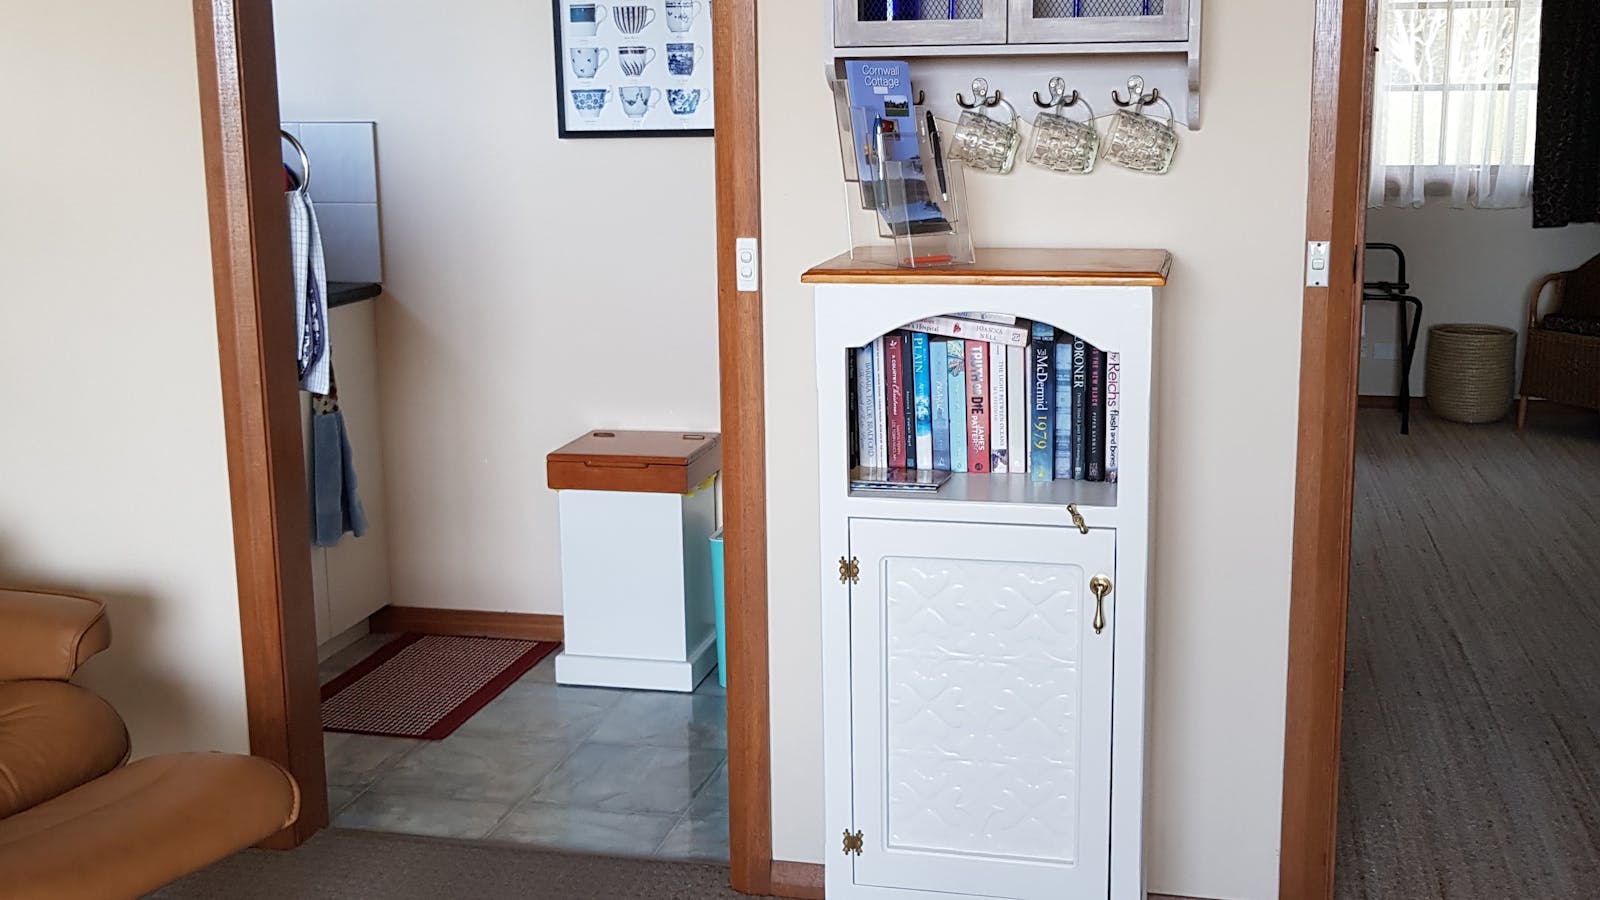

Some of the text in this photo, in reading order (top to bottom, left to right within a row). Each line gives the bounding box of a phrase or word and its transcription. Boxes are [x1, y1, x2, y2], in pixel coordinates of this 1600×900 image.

[861, 64, 901, 77] Cornwall
[864, 75, 900, 89] Cottage
[976, 325, 1003, 335] JOANNA
[913, 337, 923, 374] PLAIN
[970, 345, 984, 382] TRUTH
[1036, 348, 1047, 356] Val
[865, 362, 873, 393] BARBARA
[1036, 355, 1048, 411] McDermid
[1107, 363, 1120, 407] Reichs
[866, 395, 874, 419] TAYLOR
[891, 384, 901, 416] Christmas
[1034, 415, 1048, 449] 1979
[1109, 409, 1119, 431] flash
[977, 425, 985, 451] JAMES
[1109, 445, 1117, 468] bones
